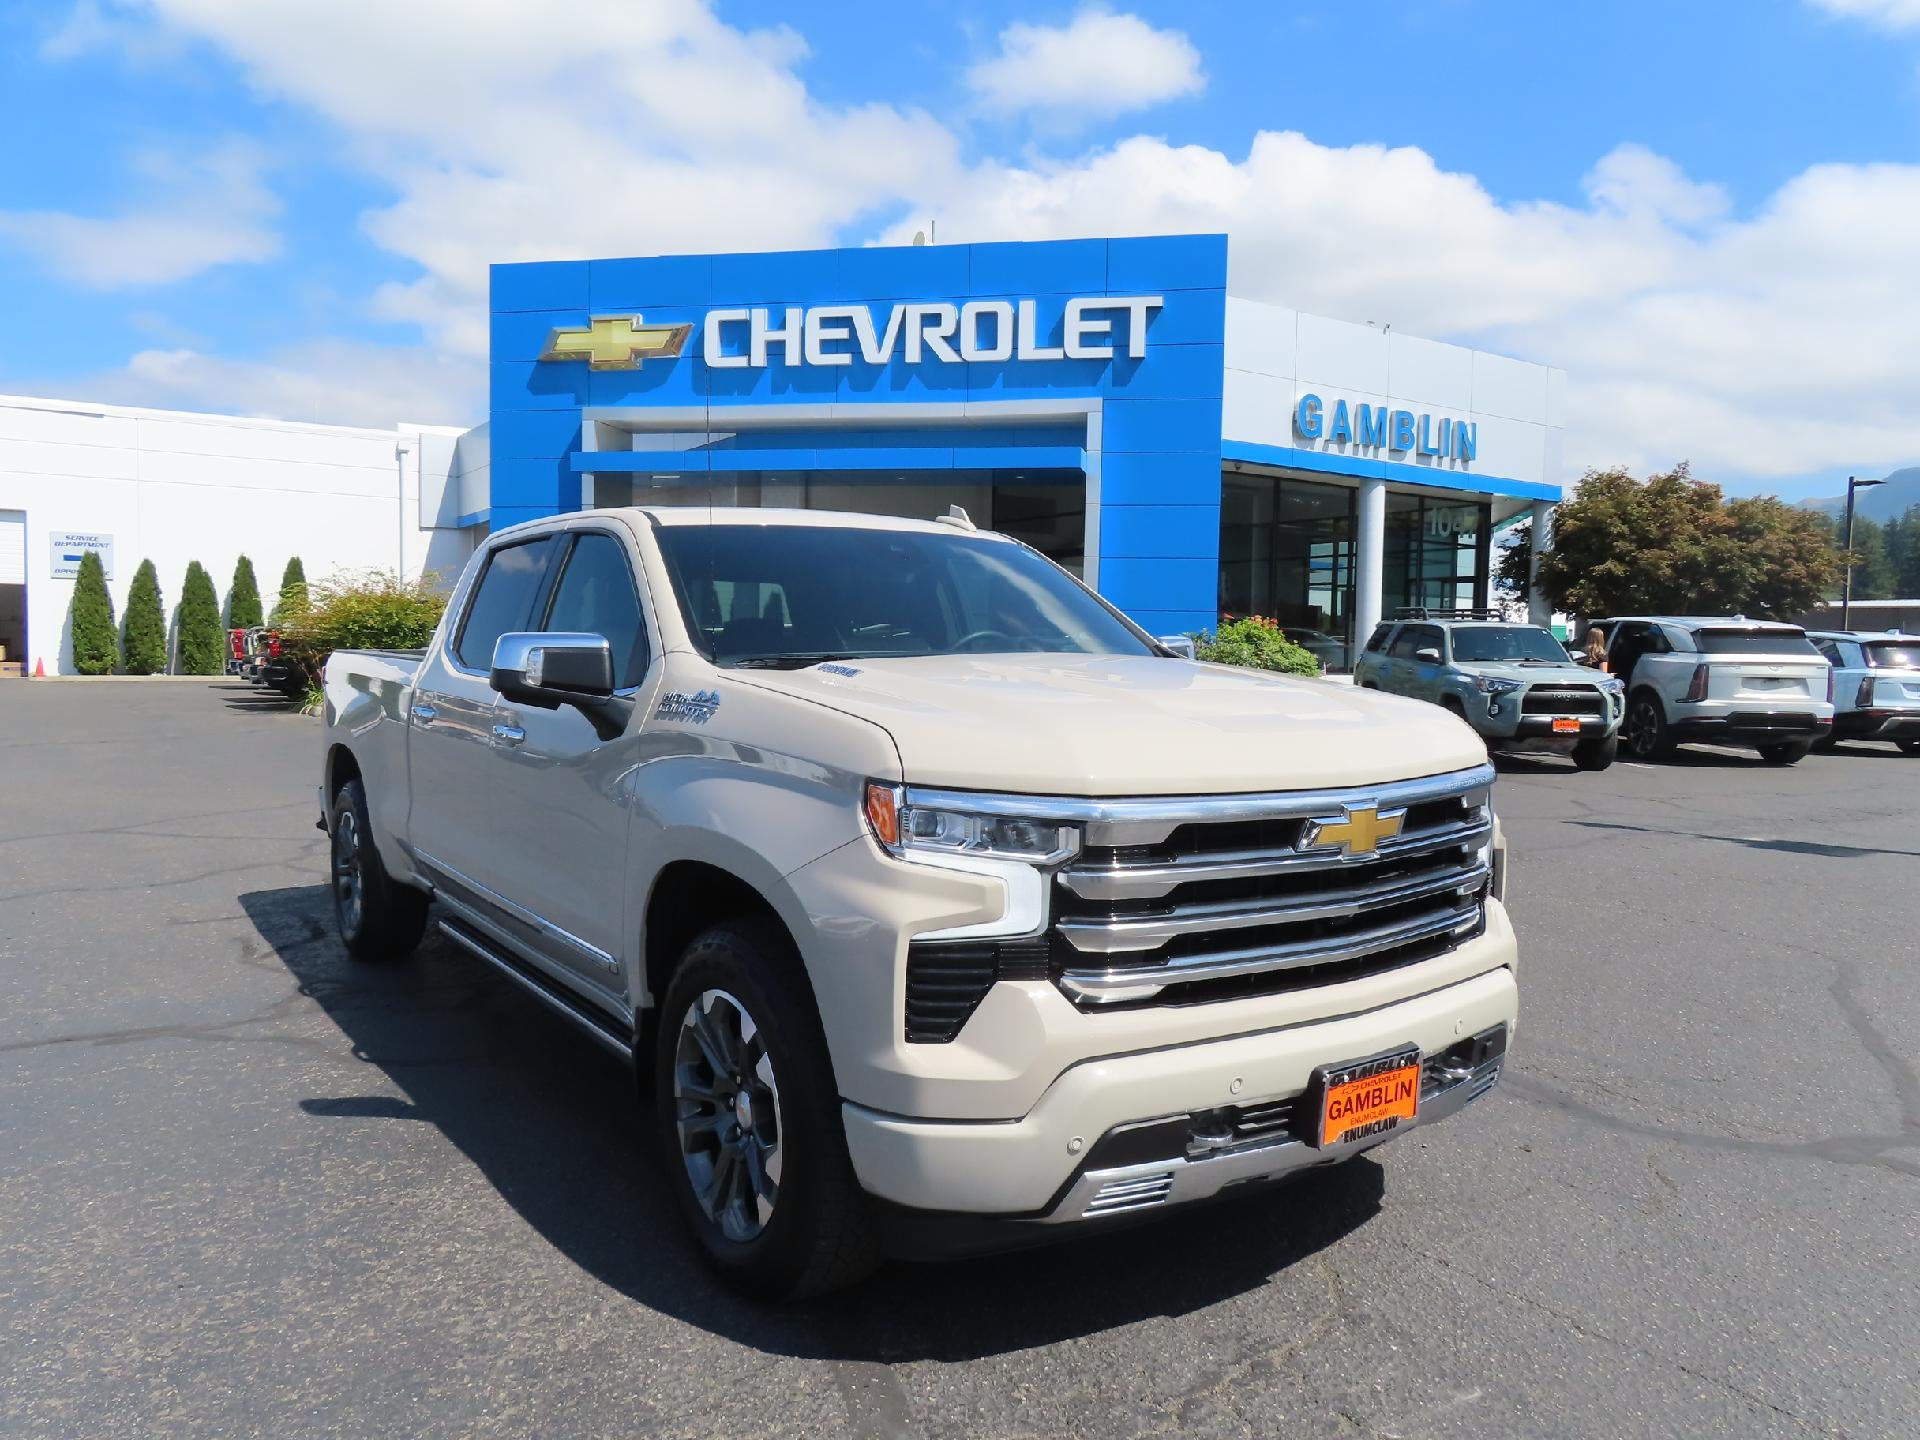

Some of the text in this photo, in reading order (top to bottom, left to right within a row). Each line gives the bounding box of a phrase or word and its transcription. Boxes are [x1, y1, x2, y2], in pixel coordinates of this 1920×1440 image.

[703, 296, 1164, 368] CHEVROLET
[1296, 393, 1477, 462] GAMBLIN
[54, 541, 110, 549] DEPARTMENT
[65, 534, 98, 542] SERVICE
[1328, 1051, 1420, 1088] GAMBLIN
[1360, 1072, 1402, 1090] CHEVROLET
[1328, 1078, 1413, 1121] GAMBLIN
[1343, 1115, 1399, 1144] ENUMCLAW
[1350, 1107, 1389, 1126] ENUMCLAW
